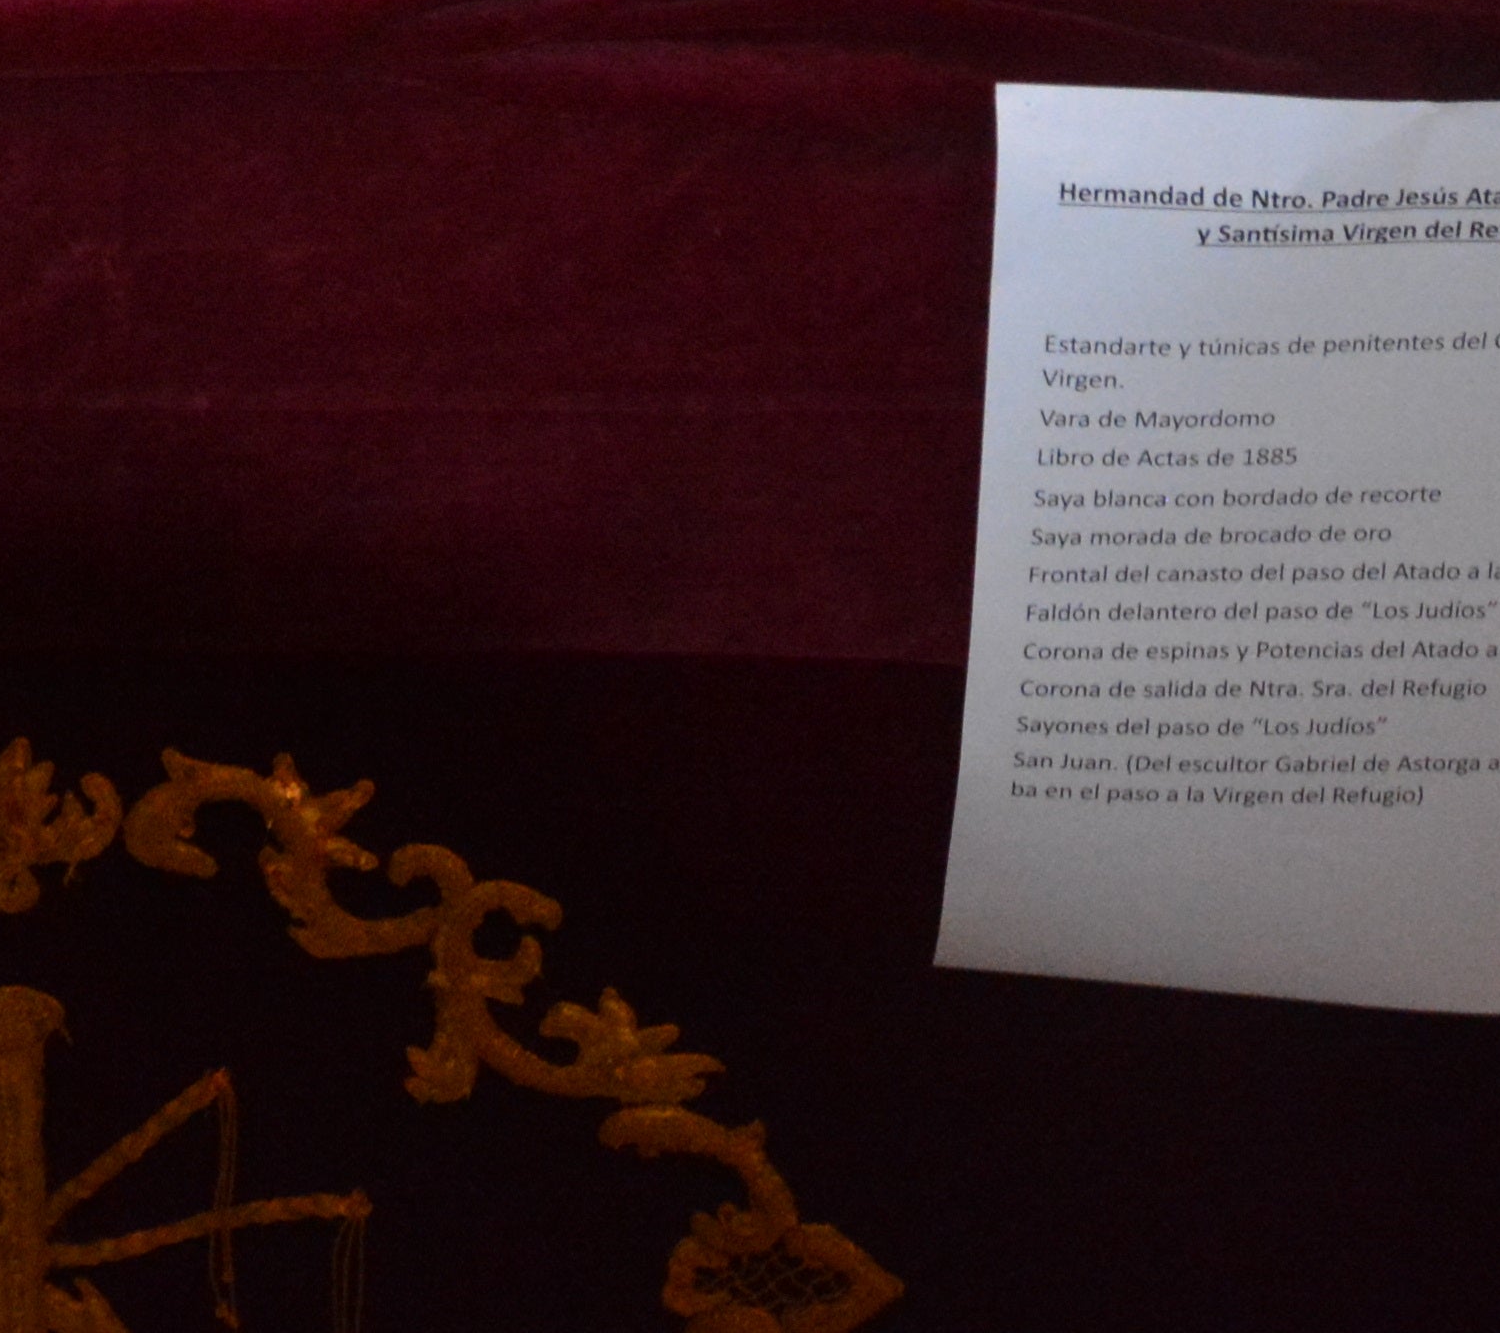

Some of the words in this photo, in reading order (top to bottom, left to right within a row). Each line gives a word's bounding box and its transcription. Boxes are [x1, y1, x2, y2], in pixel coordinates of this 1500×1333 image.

[1059, 182, 1205, 207] Hermandad
[1212, 186, 1243, 208] de
[1251, 189, 1313, 210] Ntro.
[1321, 189, 1390, 209] Padre
[1395, 187, 1458, 207] Jesús
[1197, 228, 1211, 246] y
[1218, 224, 1335, 244] Santísima
[1342, 224, 1417, 245] Virgen
[1424, 220, 1462, 239] del
[1044, 334, 1172, 357] Estandarte
[1178, 342, 1192, 360] y
[1198, 337, 1280, 357] túnicas
[1287, 335, 1316, 355] de
[1322, 334, 1445, 358] penitentes
[1451, 331, 1488, 351] del
[1041, 368, 1124, 393] Virgen.
[1039, 408, 1091, 428] Vara
[1097, 409, 1127, 428] de
[1134, 408, 1276, 432] Mayordomo
[1037, 447, 1095, 467] Libro
[1101, 448, 1130, 467] de
[1136, 449, 1199, 467] Actas
[1206, 448, 1235, 467] de
[1243, 447, 1298, 467] 1885
[1034, 489, 1085, 512] Saya
[1093, 489, 1167, 508] blanca
[1174, 493, 1215, 508] con
[1222, 487, 1319, 507] bordado
[1324, 485, 1354, 505] de
[1360, 486, 1442, 504] recorte
[1031, 527, 1082, 549] Saya
[1089, 527, 1177, 546] morada
[1184, 527, 1212, 545] de
[1219, 524, 1312, 545] brocado
[1318, 524, 1347, 543] de
[1353, 527, 1393, 542] oro
[1028, 564, 1108, 584] Frontal
[1114, 564, 1150, 583] del
[1156, 566, 1244, 583] canasto
[1250, 562, 1285, 582] del
[1291, 567, 1345, 585] paso
[1351, 561, 1387, 582] del
[1393, 561, 1461, 581] Atado
[1467, 566, 1480, 580] a
[1025, 603, 1101, 622] Faldón
[1107, 602, 1217, 622] delantero
[1223, 601, 1258, 620] del
[1265, 606, 1319, 624] paso
[1325, 601, 1354, 621] de
[1022, 642, 1104, 661] Corona
[1111, 641, 1139, 661] de
[1145, 645, 1230, 664] espinas
[1236, 645, 1249, 663] y
[1256, 640, 1364, 659] Potencias
[1370, 640, 1405, 659] del
[1411, 640, 1479, 659] Atado
[1485, 644, 1499, 659] a
[1019, 679, 1101, 698] Corona
[1108, 680, 1136, 698] de
[1143, 680, 1207, 699] salida
[1214, 679, 1242, 698] de
[1249, 680, 1304, 698] Ntra.
[1312, 679, 1353, 698] Sra.
[1360, 678, 1395, 698] del
[1402, 678, 1488, 701] Refugio
[1016, 715, 1109, 737] Sayones
[1115, 717, 1151, 735] del
[1156, 722, 1210, 740] paso
[1216, 718, 1245, 736] de
[1013, 751, 1054, 769] San
[1060, 753, 1116, 771] Juan.
[1126, 754, 1172, 775] (Del
[1178, 755, 1269, 773] escultor
[1274, 754, 1356, 773] Gabriel
[1362, 754, 1390, 772] de
[1396, 755, 1481, 777] Astorga
[1010, 780, 1038, 798] ba
[1044, 786, 1073, 799] en
[1079, 783, 1100, 801] el
[1106, 788, 1160, 805] paso
[1166, 789, 1179, 803] a
[1186, 785, 1205, 803] la
[1212, 786, 1284, 808] Virgen
[1291, 786, 1325, 805] del
[1332, 785, 1424, 808] Refugio)
